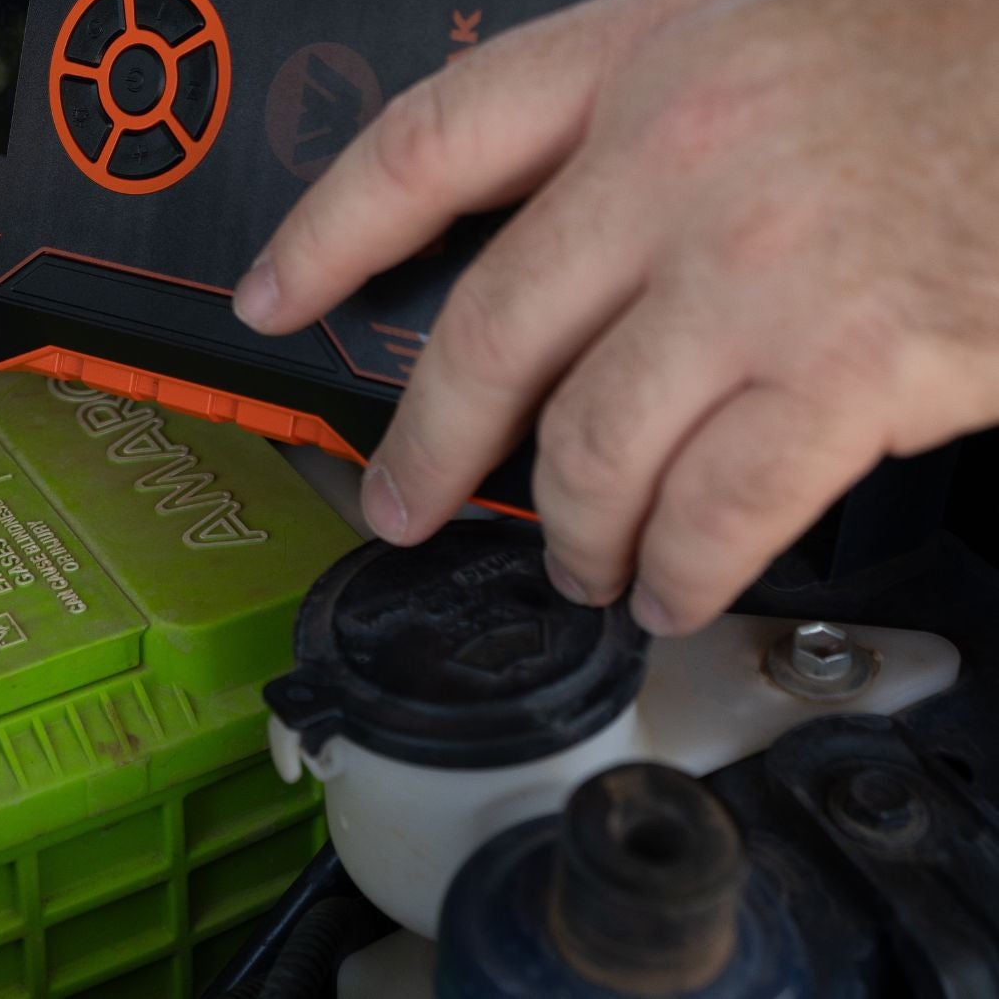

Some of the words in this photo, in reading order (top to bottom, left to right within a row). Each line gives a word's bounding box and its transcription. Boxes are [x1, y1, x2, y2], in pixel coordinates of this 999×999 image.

[26, 519, 66, 557] INJURY
[30, 552, 69, 590] CAUSE
[57, 553, 80, 572] OR
[56, 589, 87, 614] CAN
